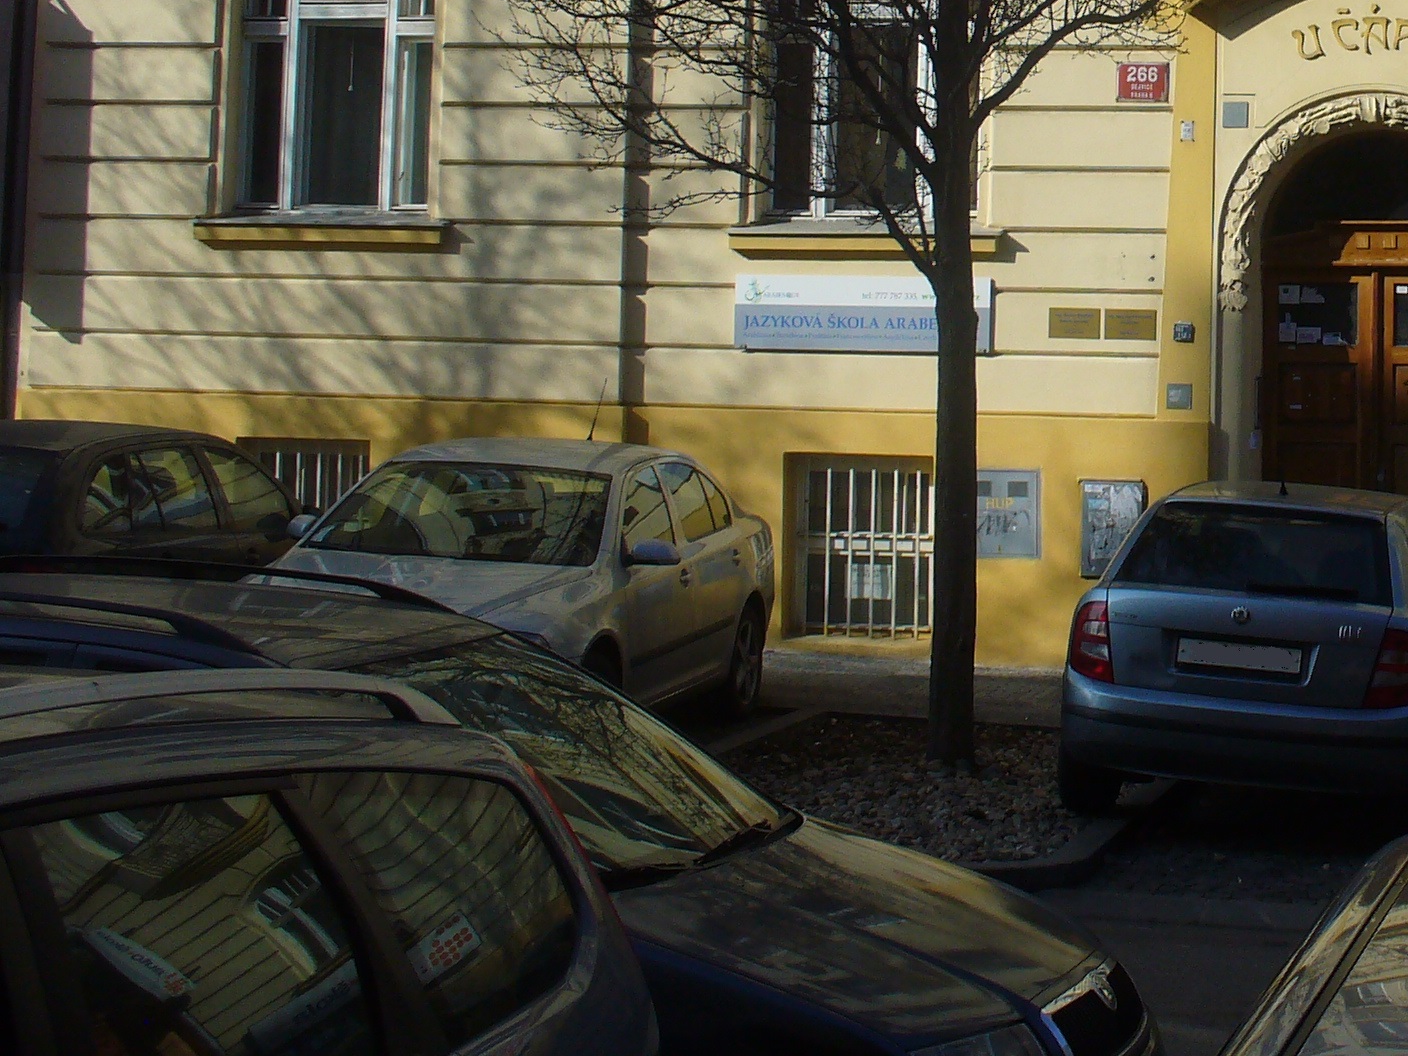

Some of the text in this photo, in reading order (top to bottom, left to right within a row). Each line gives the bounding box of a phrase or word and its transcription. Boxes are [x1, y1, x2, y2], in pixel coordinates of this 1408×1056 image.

[1291, 24, 1326, 61] U
[1126, 65, 1158, 83] 266
[744, 312, 823, 330] JAZYKOVÁ
[827, 313, 880, 330] ŠKOLA
